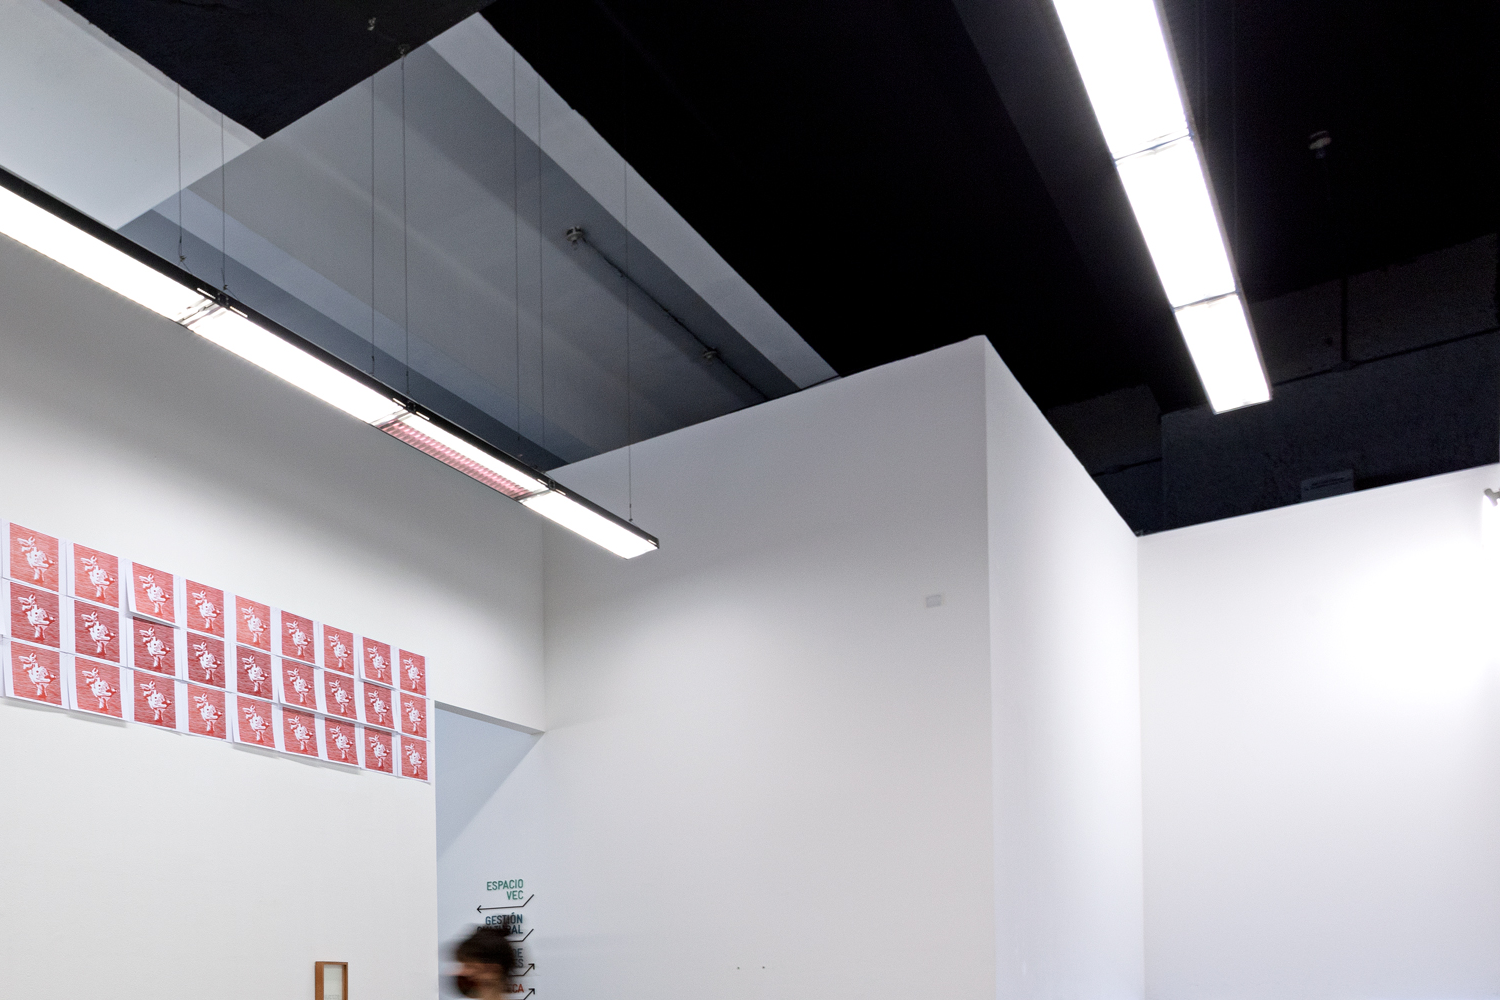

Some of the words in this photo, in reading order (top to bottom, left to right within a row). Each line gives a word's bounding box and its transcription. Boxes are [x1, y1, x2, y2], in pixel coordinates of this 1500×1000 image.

[486, 878, 524, 891] ESPACIO
[506, 889, 524, 900] VEC
[485, 911, 523, 926] GESTIÓN
